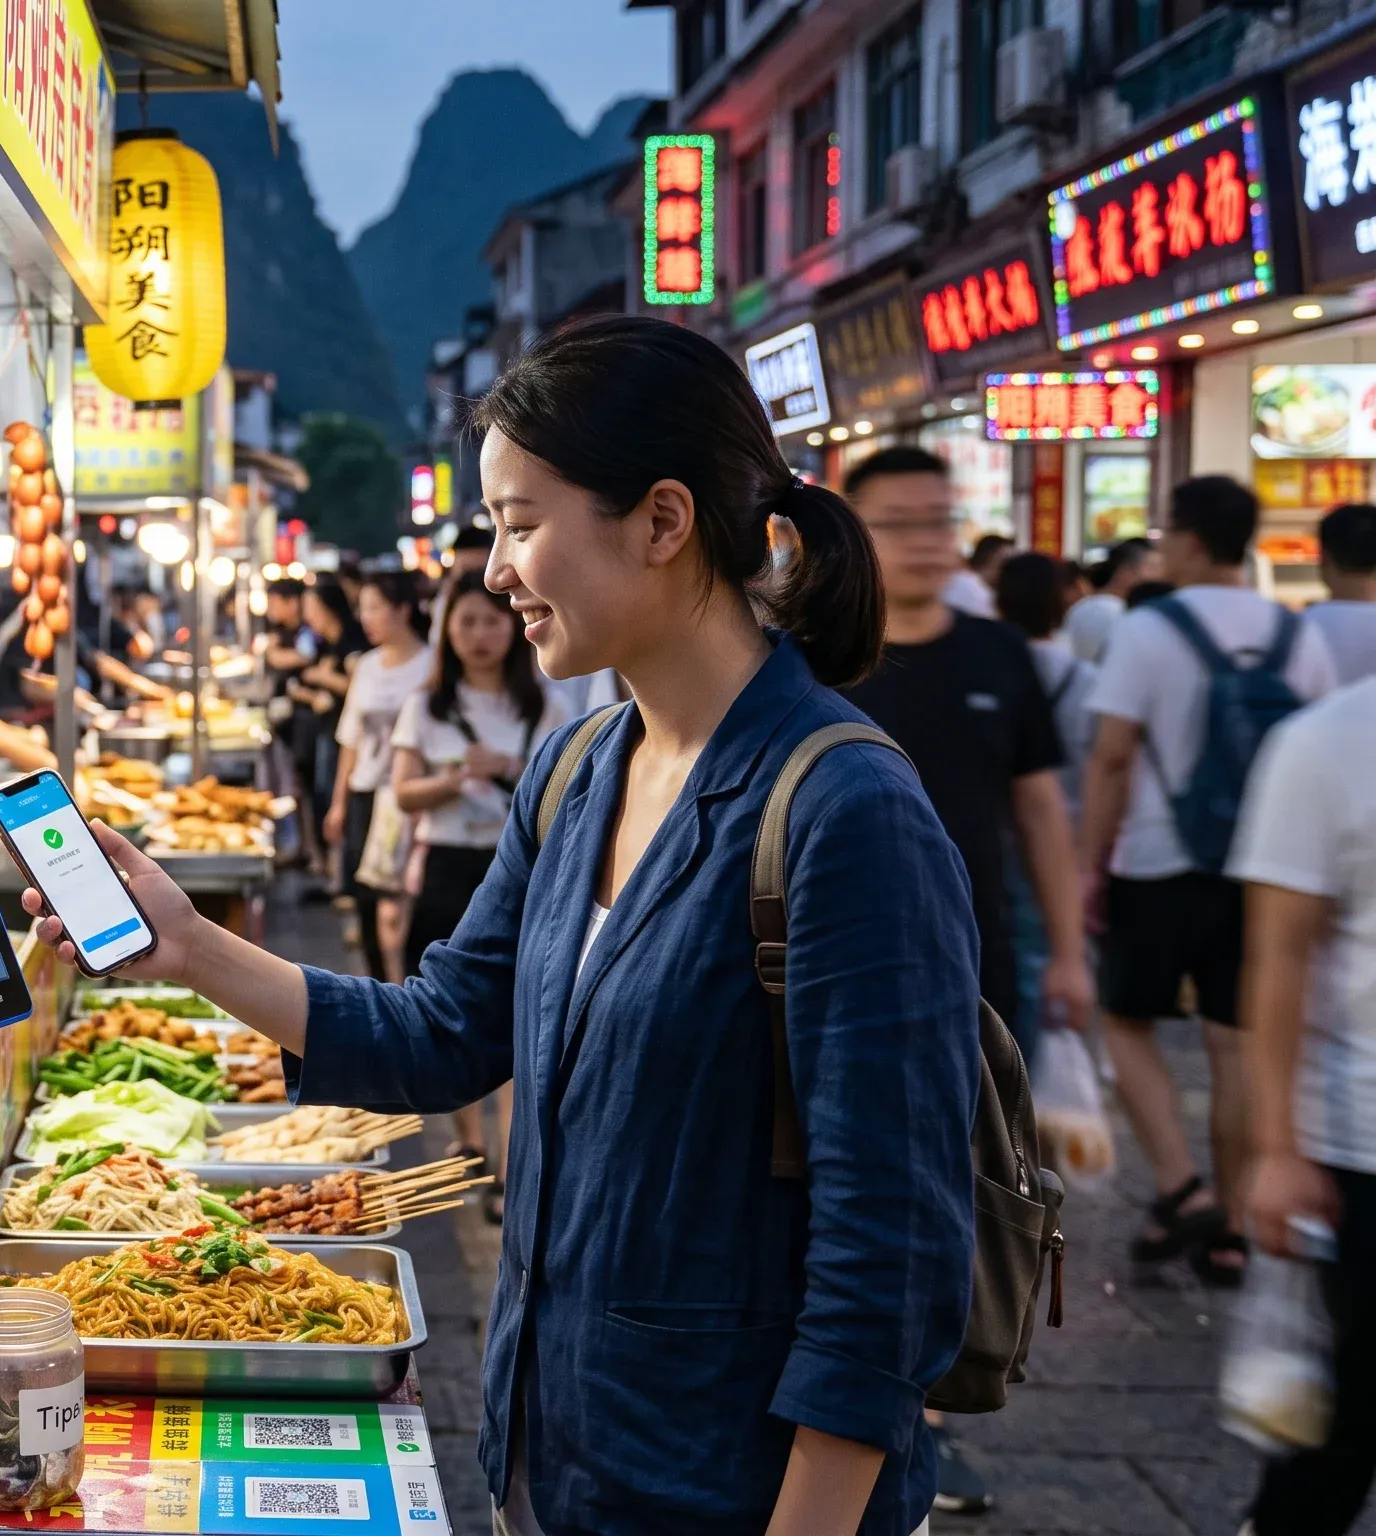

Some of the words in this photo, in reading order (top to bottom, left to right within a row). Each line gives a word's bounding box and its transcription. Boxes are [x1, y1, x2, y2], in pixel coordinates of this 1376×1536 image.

[112, 178, 179, 361] 阳朔美食
[996, 383, 1146, 429] 阳朔美食
